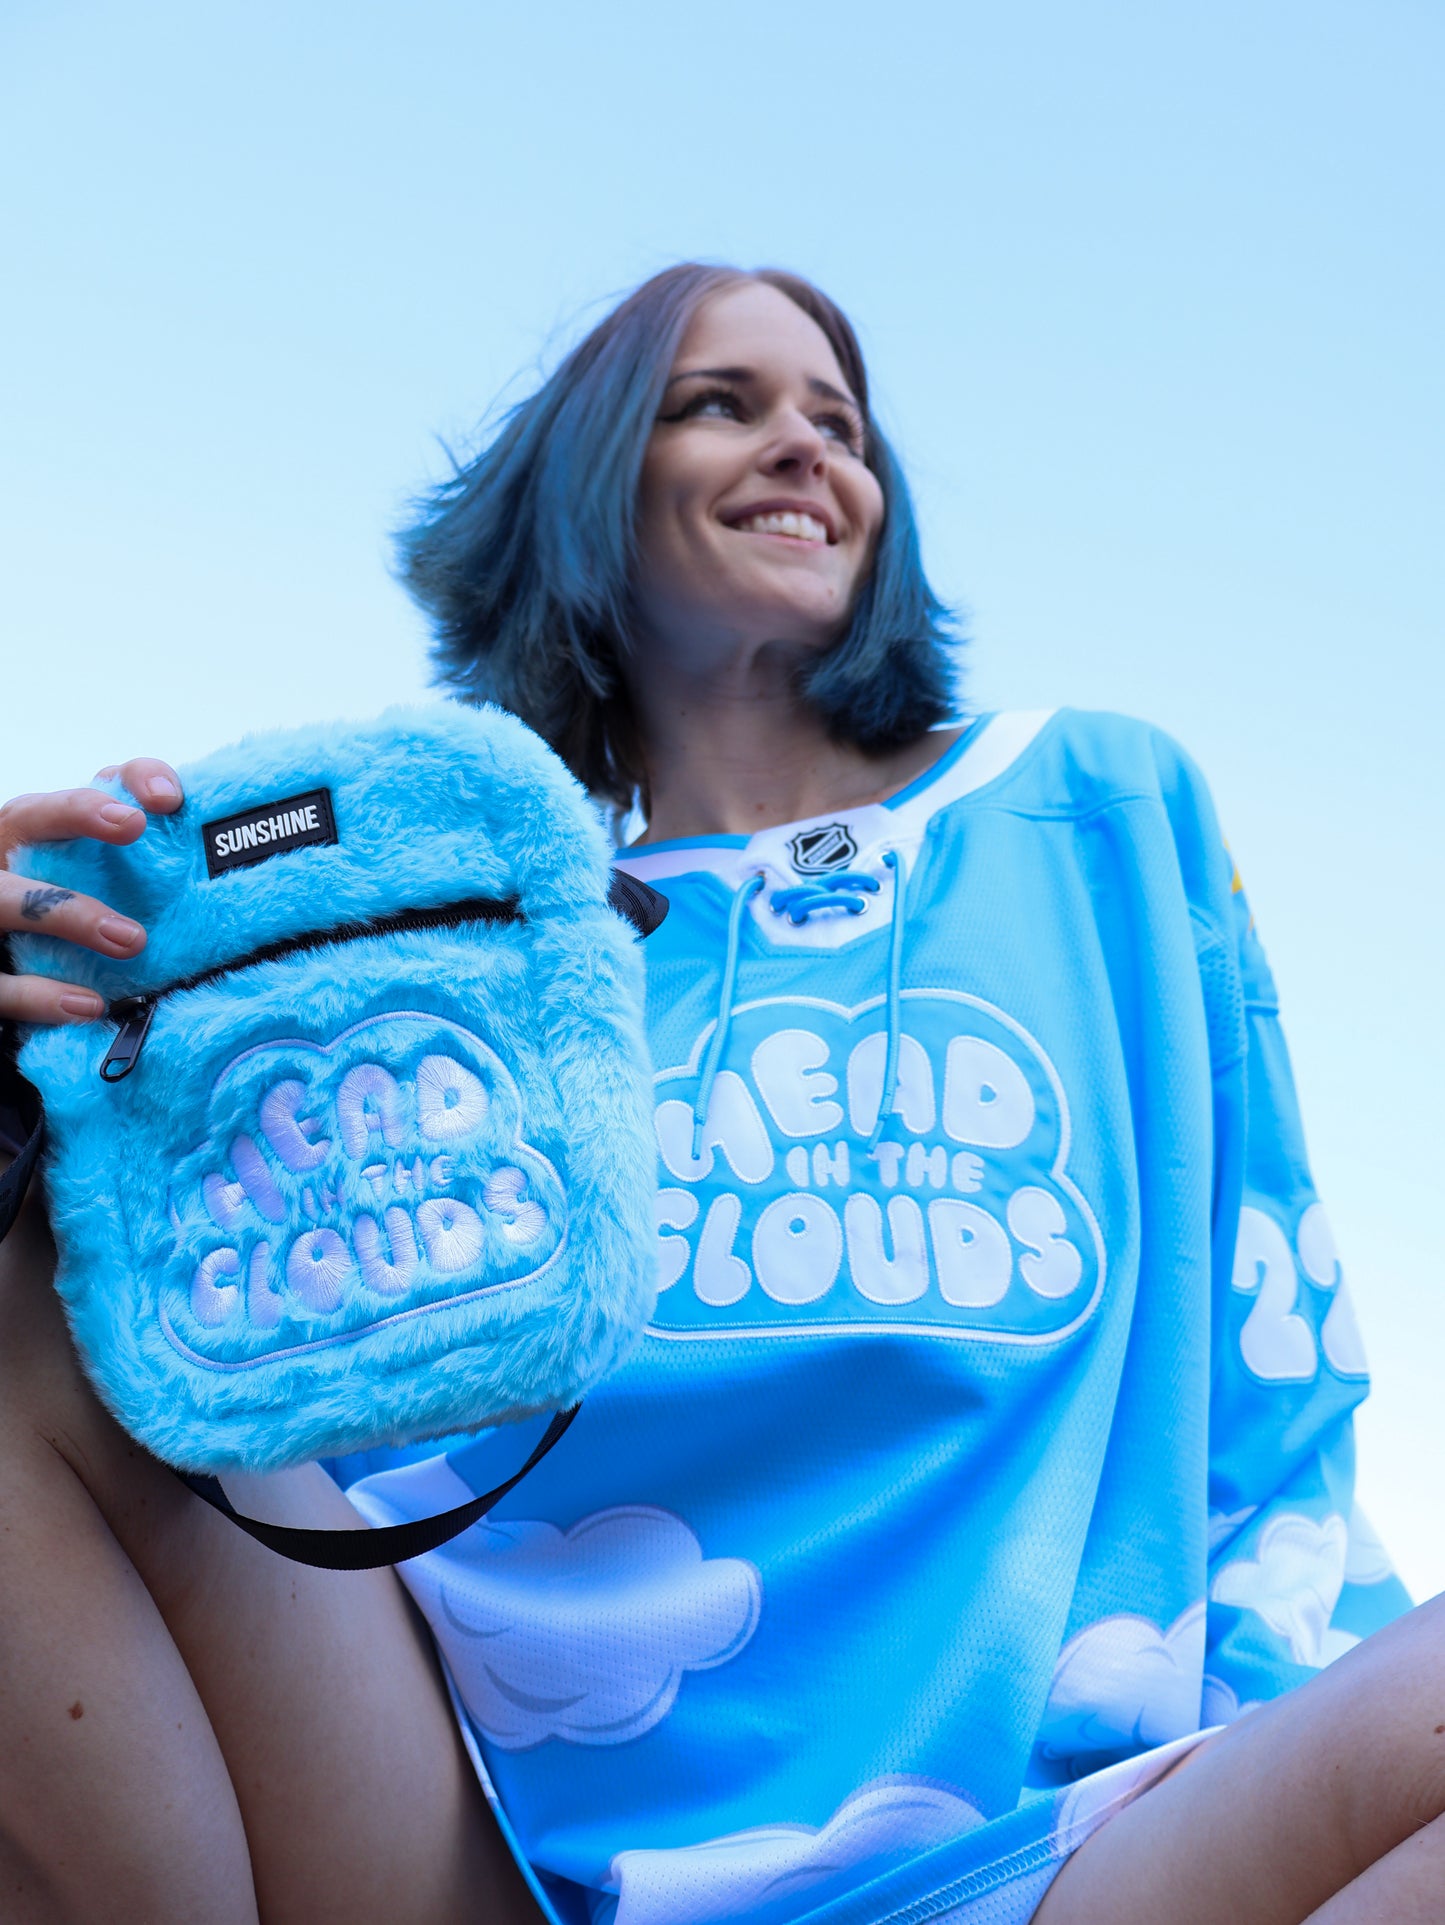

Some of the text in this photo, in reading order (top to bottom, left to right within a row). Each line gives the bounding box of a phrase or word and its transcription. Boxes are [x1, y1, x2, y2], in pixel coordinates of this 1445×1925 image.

[215, 804, 321, 858] SUNSHINE
[202, 1054, 490, 1232] HEAD
[653, 1028, 1036, 1186] HEAD
[303, 1154, 454, 1221] IN THE
[786, 1140, 986, 1194] IN THE
[190, 1165, 547, 1330] CLOUDS
